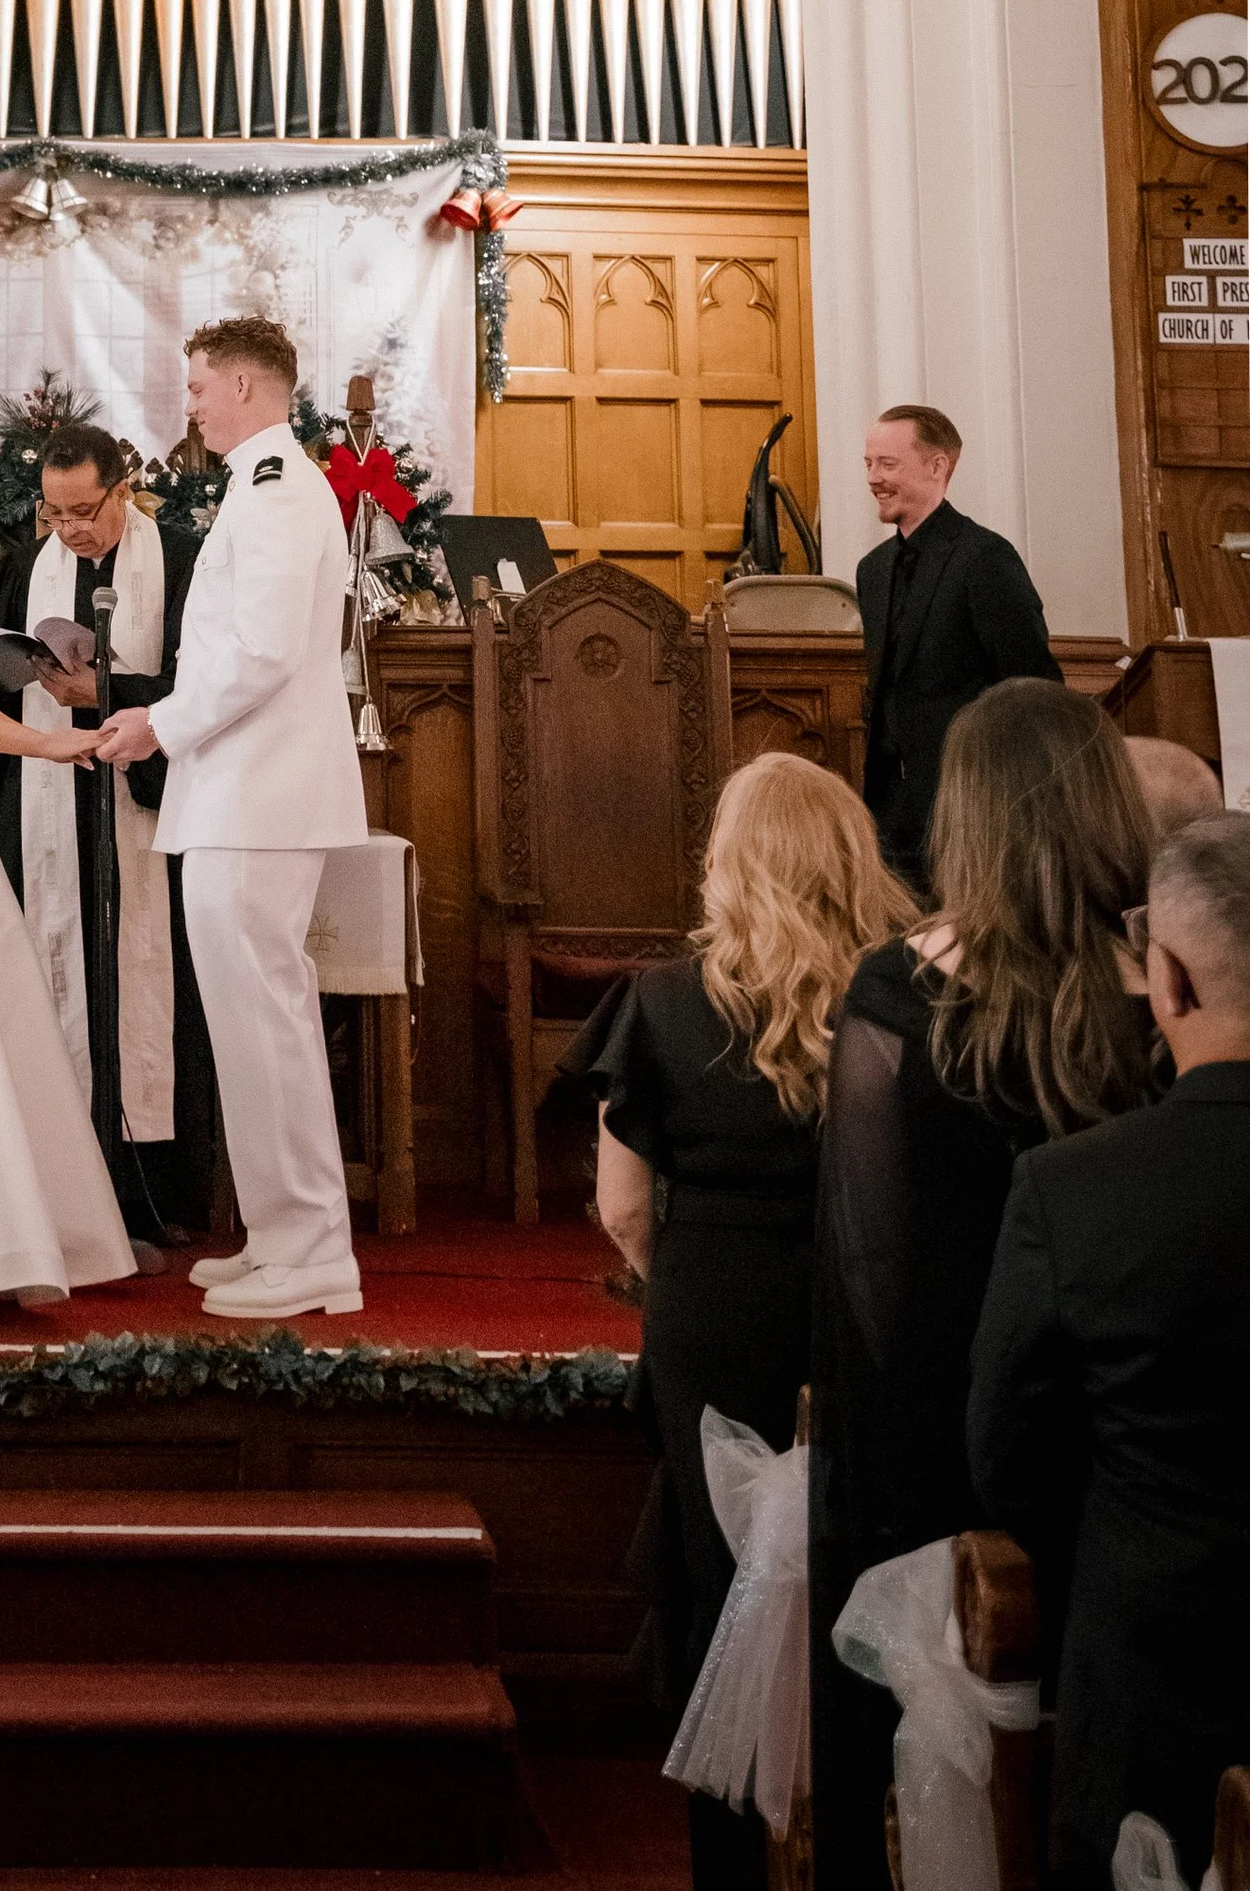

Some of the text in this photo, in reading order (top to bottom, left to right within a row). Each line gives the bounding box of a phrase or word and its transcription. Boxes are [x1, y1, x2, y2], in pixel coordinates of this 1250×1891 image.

[1152, 55, 1248, 105] 202
[1189, 244, 1246, 265] WELCOME
[1171, 281, 1203, 302] FIRST
[1162, 318, 1209, 339] CHURCH
[1220, 320, 1234, 340] OF
